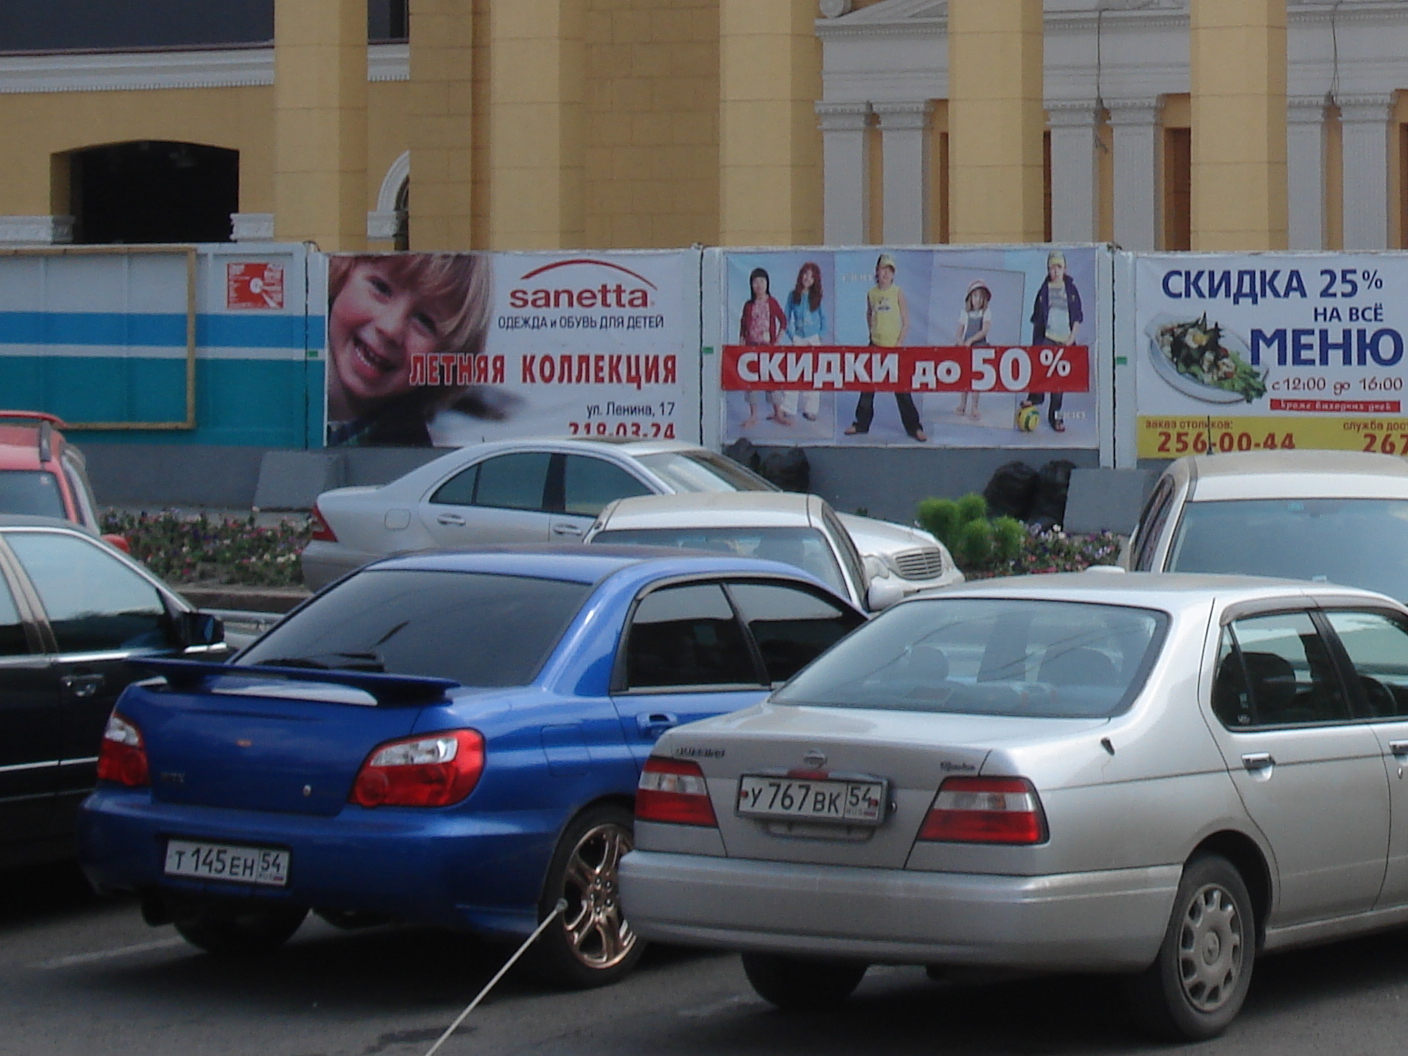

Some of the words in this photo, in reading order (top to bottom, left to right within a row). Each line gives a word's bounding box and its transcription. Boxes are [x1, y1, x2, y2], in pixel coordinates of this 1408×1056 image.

[509, 283, 648, 309] sanetta
[1162, 269, 1308, 305] СКИДКА
[1319, 269, 1383, 298] 25%
[498, 315, 548, 331] ОДЕЖДА
[550, 318, 557, 328] и
[559, 316, 597, 329] ОБУВЬ
[599, 315, 625, 331] ДЛЯ
[626, 313, 665, 332] ДЕТЕЙ
[1313, 307, 1342, 322] НА
[1349, 302, 1384, 322] ВСЁ
[1250, 328, 1404, 367] МЕНЮ
[409, 353, 505, 386] ЛЕТНЯЯ
[521, 353, 677, 390] КОЛЛЕКЦИЯ
[737, 352, 899, 389] СКИДКИ
[911, 360, 961, 390] до
[586, 404, 602, 419] ул.
[606, 401, 656, 418] Ленина,
[659, 402, 676, 416] 17
[1146, 420, 1177, 429] заказ
[1343, 421, 1384, 433] служба
[1157, 431, 1297, 454] 256-00-44
